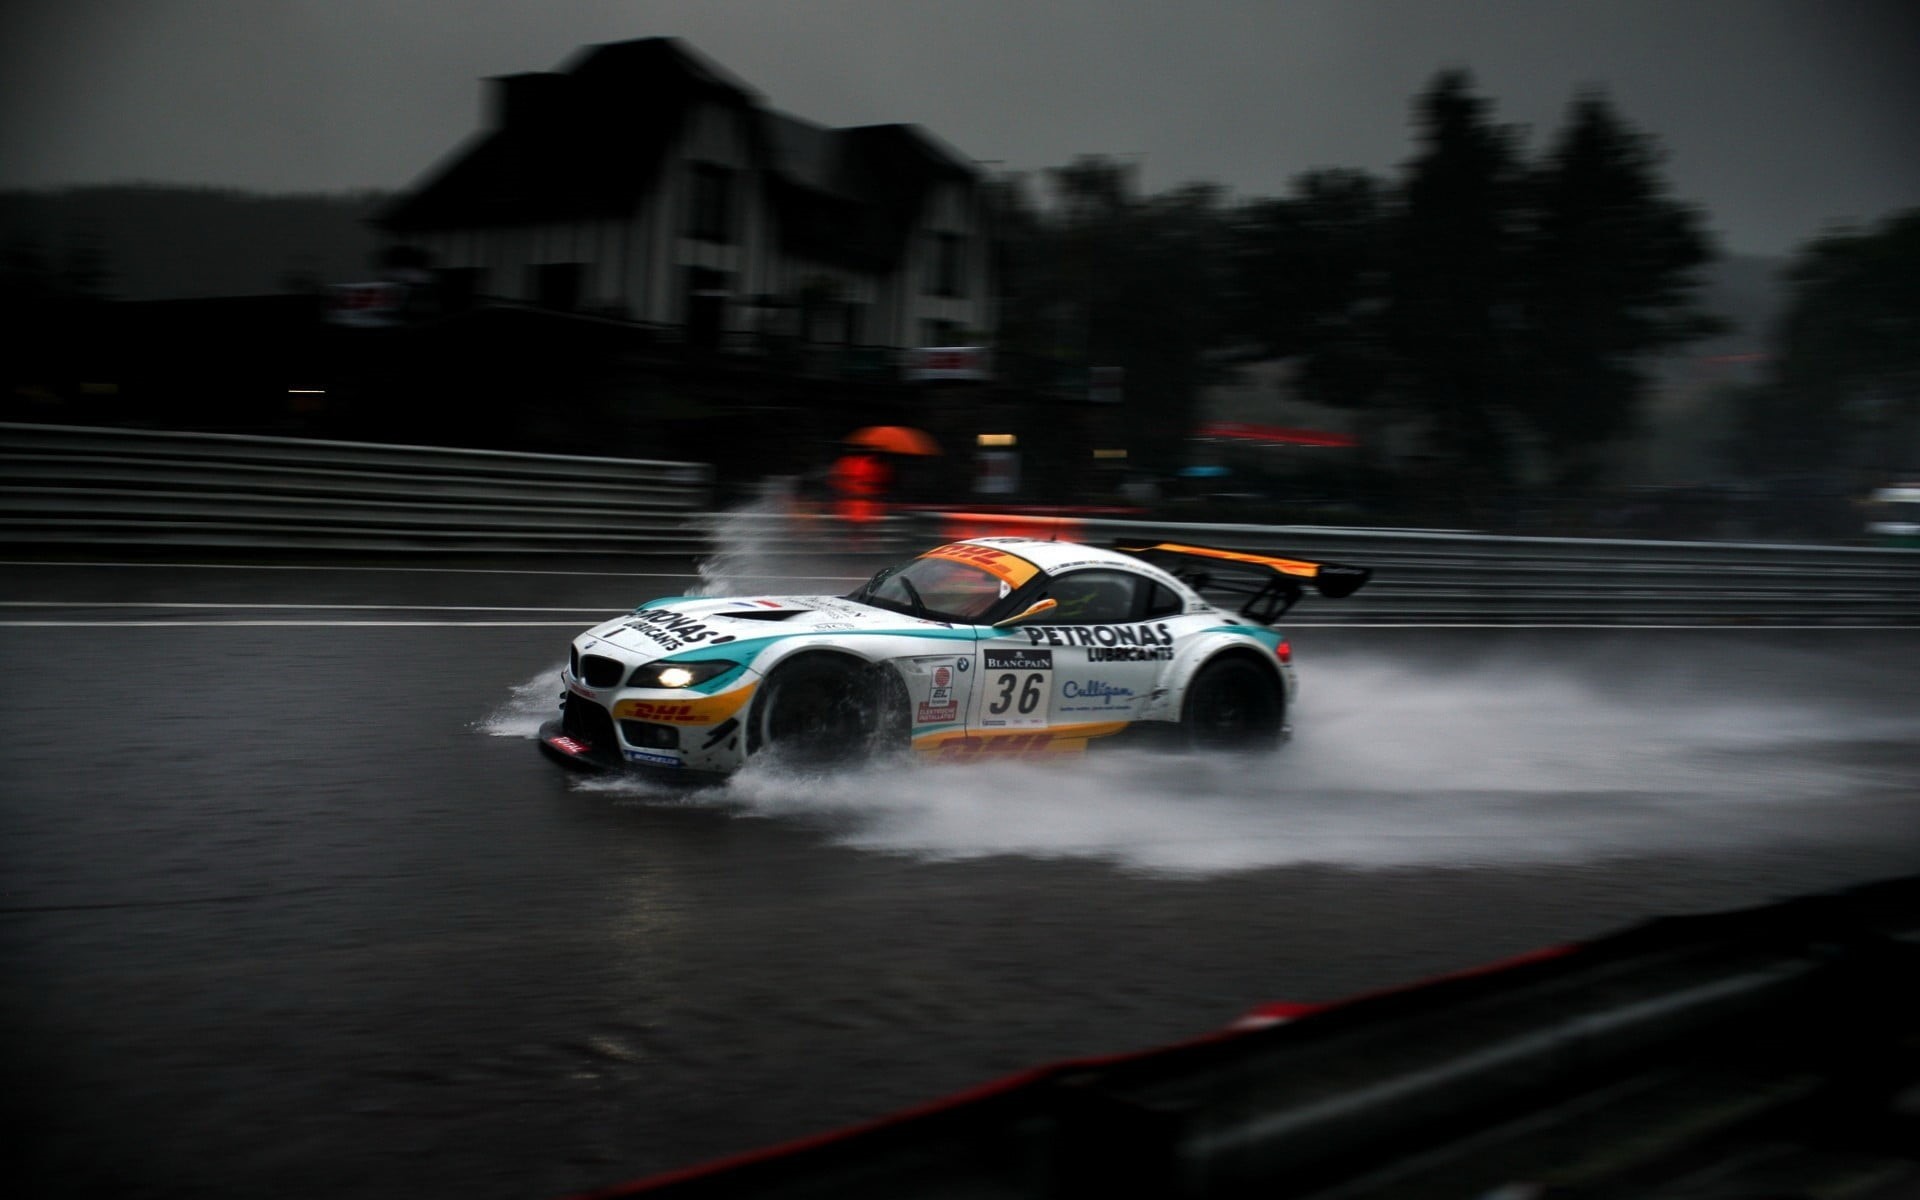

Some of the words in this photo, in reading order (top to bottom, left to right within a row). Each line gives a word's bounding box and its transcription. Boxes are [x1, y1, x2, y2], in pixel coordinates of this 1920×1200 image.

[627, 608, 719, 643] TRONAS
[1024, 623, 1173, 647] PETRONAS
[988, 658, 1051, 668] BLANCPAIN
[1087, 647, 1174, 662] LUBRICANTS
[933, 689, 948, 699] EL
[989, 673, 1044, 715] 36
[1063, 680, 1134, 705] Culligan
[634, 703, 698, 722] DHL
[556, 736, 583, 754] TOTAL
